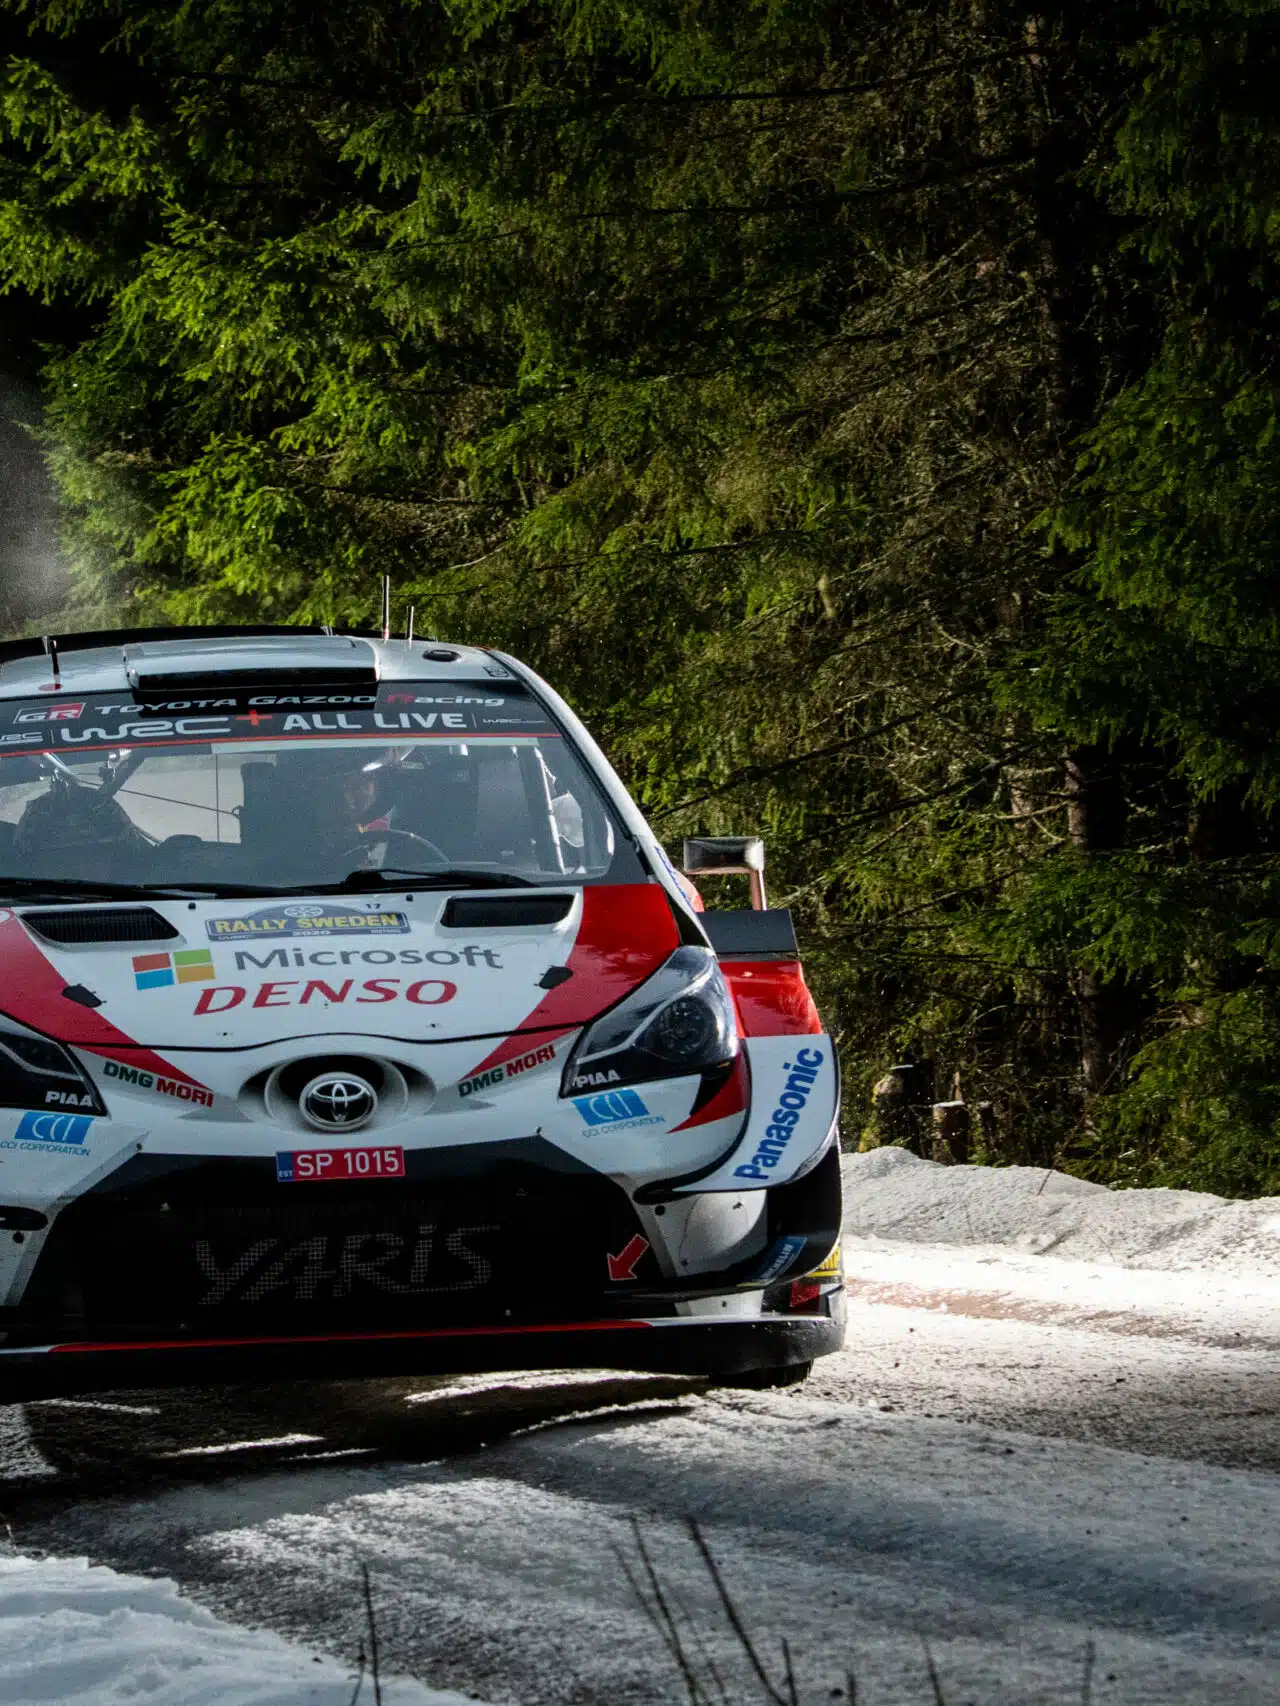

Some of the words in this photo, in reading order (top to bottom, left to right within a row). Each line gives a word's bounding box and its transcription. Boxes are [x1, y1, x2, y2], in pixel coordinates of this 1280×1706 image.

[94, 699, 237, 715] TOYOTA
[248, 694, 377, 707] GAZOO
[387, 694, 504, 707] Racing
[282, 713, 362, 731] ALL
[374, 712, 468, 729] LIVE
[215, 918, 288, 933] RALLY
[296, 913, 399, 929] SWEDEN
[234, 945, 504, 971] Microsoft
[193, 977, 458, 1016] DENSO
[458, 1067, 506, 1097] DMG
[506, 1045, 557, 1078] MORI
[577, 1068, 621, 1088] PIAA
[103, 1059, 154, 1089] DMG
[156, 1076, 215, 1108] MORI
[45, 1090, 94, 1107] PIAA
[732, 1047, 825, 1181] Panasonic
[0, 1140, 19, 1151] CCI
[19, 1141, 91, 1157] CORPORATION
[296, 1153, 334, 1176] SP
[343, 1149, 399, 1174] 1015
